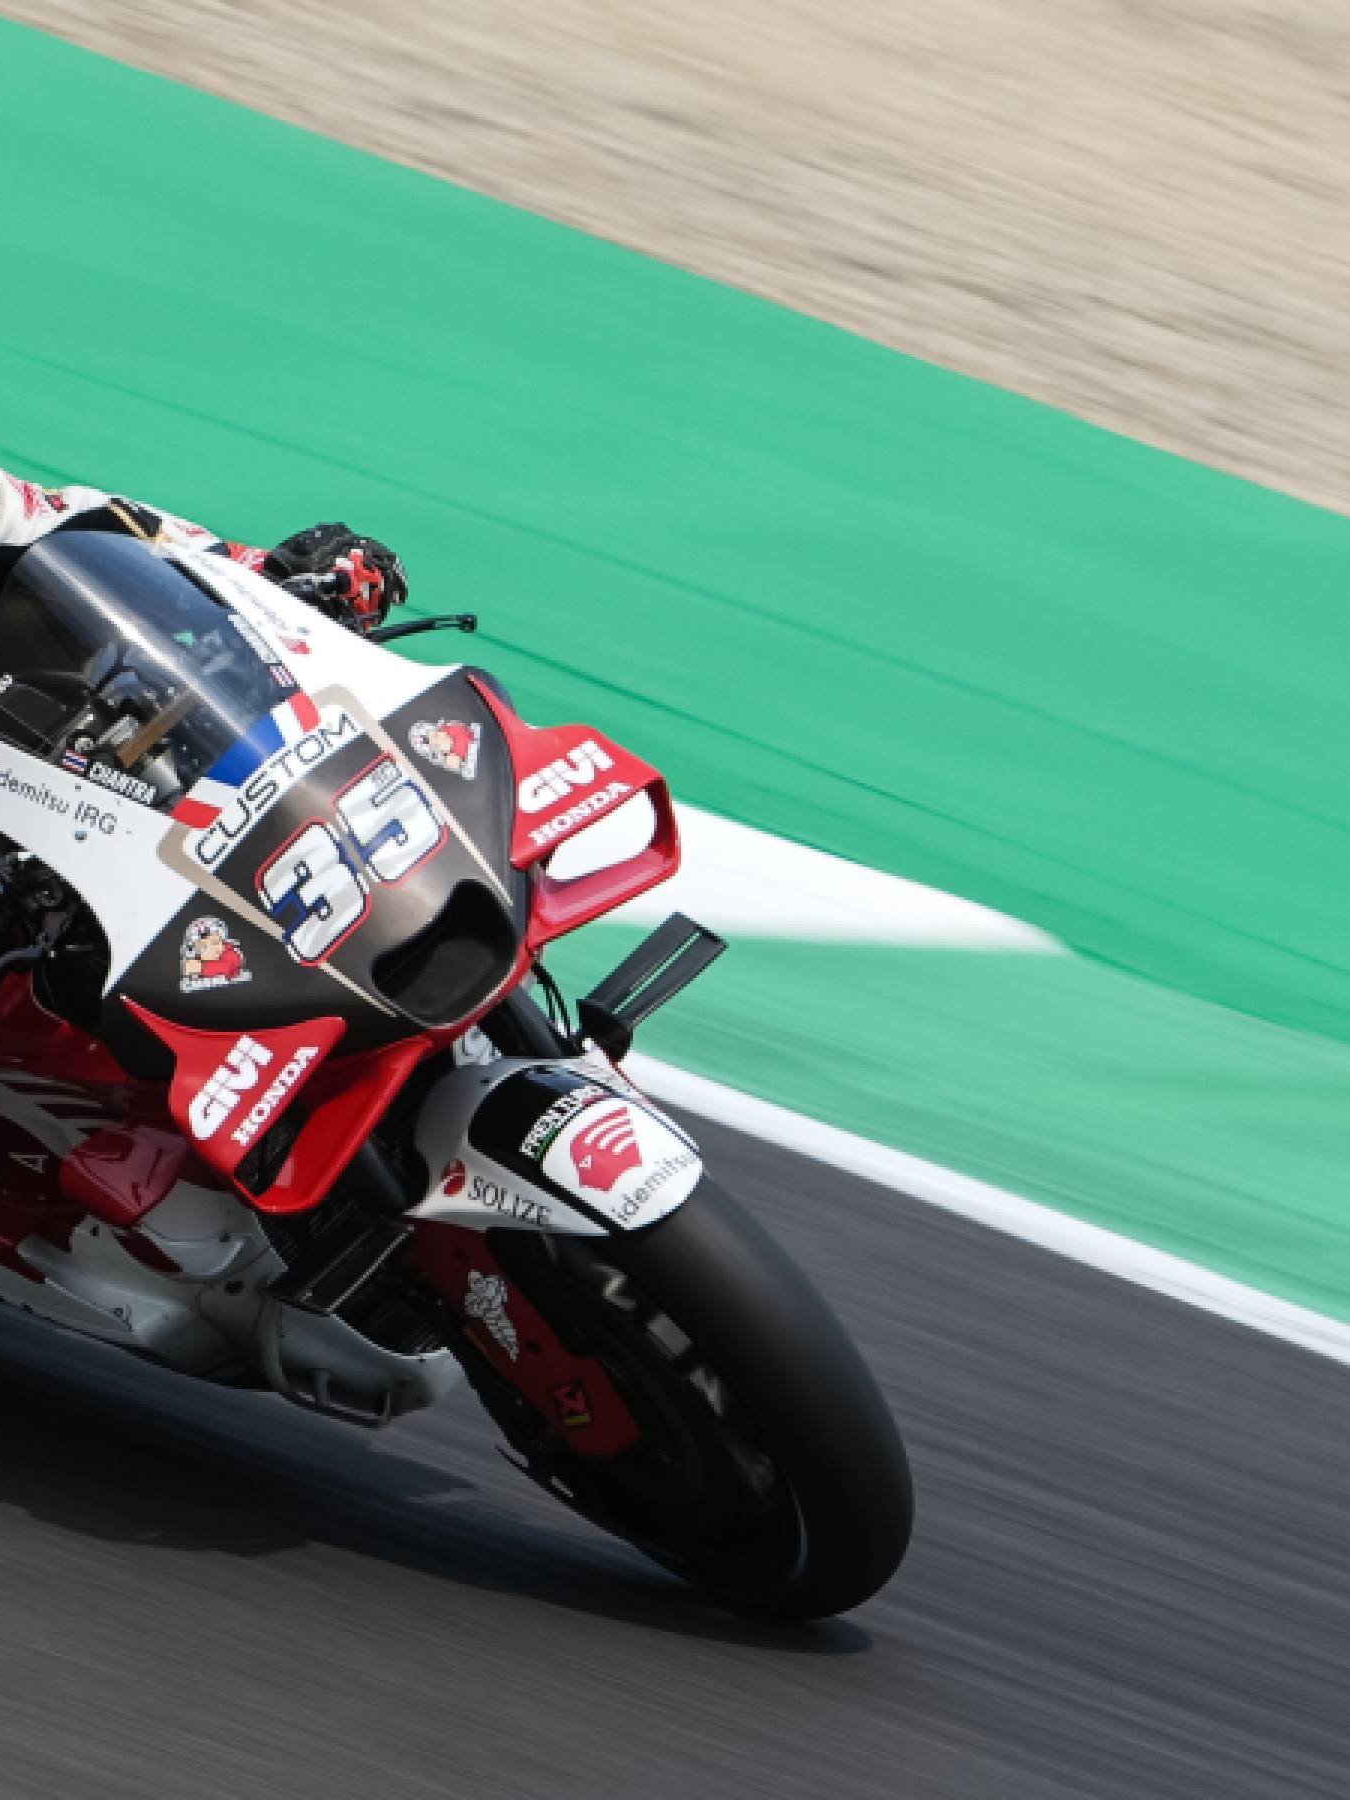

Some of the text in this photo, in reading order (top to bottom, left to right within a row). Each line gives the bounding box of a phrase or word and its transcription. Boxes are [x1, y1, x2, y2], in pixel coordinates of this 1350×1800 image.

[195, 713, 359, 865] CUSTOM
[519, 740, 614, 813] GIVI
[74, 800, 118, 835] IRG
[528, 782, 632, 846] HONDA
[256, 752, 447, 967] 35
[188, 1035, 274, 1141] GIVI
[230, 1046, 319, 1147] HONDA
[467, 1176, 552, 1227] SOLIZE
[610, 1152, 697, 1225] idemitsu
